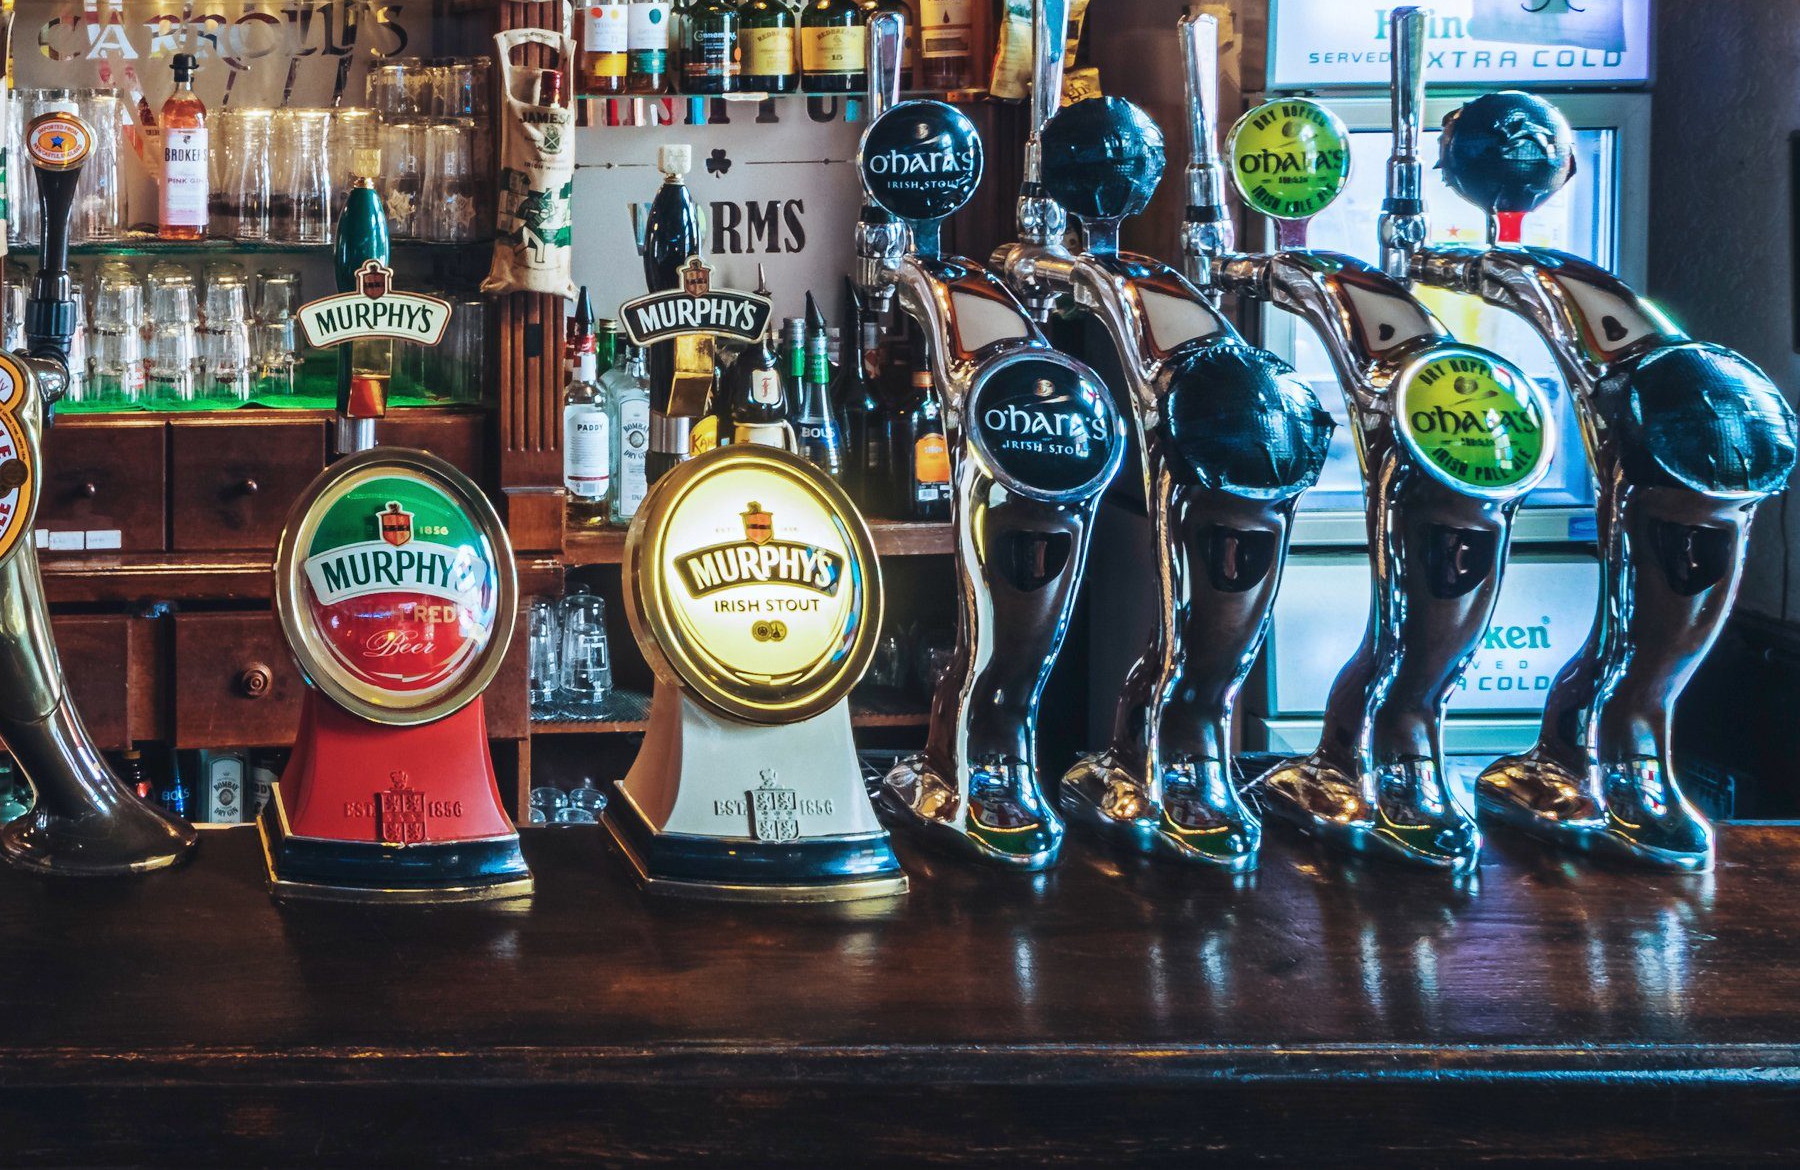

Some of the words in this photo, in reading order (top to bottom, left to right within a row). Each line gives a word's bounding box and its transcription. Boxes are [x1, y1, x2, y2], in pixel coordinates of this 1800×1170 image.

[1309, 51, 1391, 64] SERVED
[1422, 51, 1517, 68] XTRA
[1533, 50, 1622, 68] COLD
[1252, 106, 1279, 132] DRY
[887, 181, 919, 189] IRISH
[315, 301, 434, 336] MURPHY'S
[636, 297, 758, 333] MURPHY'S
[1418, 362, 1446, 387] DRY
[1450, 359, 1501, 382] HOPP
[577, 423, 604, 431] PADDY
[1007, 441, 1043, 452] IRISH
[1431, 446, 1470, 477] IRISH
[1512, 448, 1533, 473] ALE
[419, 526, 449, 536] 1856
[321, 549, 471, 595] MURPHY
[687, 543, 833, 591] MURPHY'S
[413, 605, 456, 624] RED
[715, 599, 760, 612] IRISH
[766, 598, 820, 613] STOUT
[362, 629, 437, 658] Beer
[1478, 675, 1550, 691] COLD
[161, 787, 190, 801] BOLS
[213, 780, 240, 792] BOMBAY
[214, 807, 227, 818] DRY
[226, 806, 239, 817] GIN
[428, 800, 463, 817] 1856
[799, 798, 834, 816] 1856
